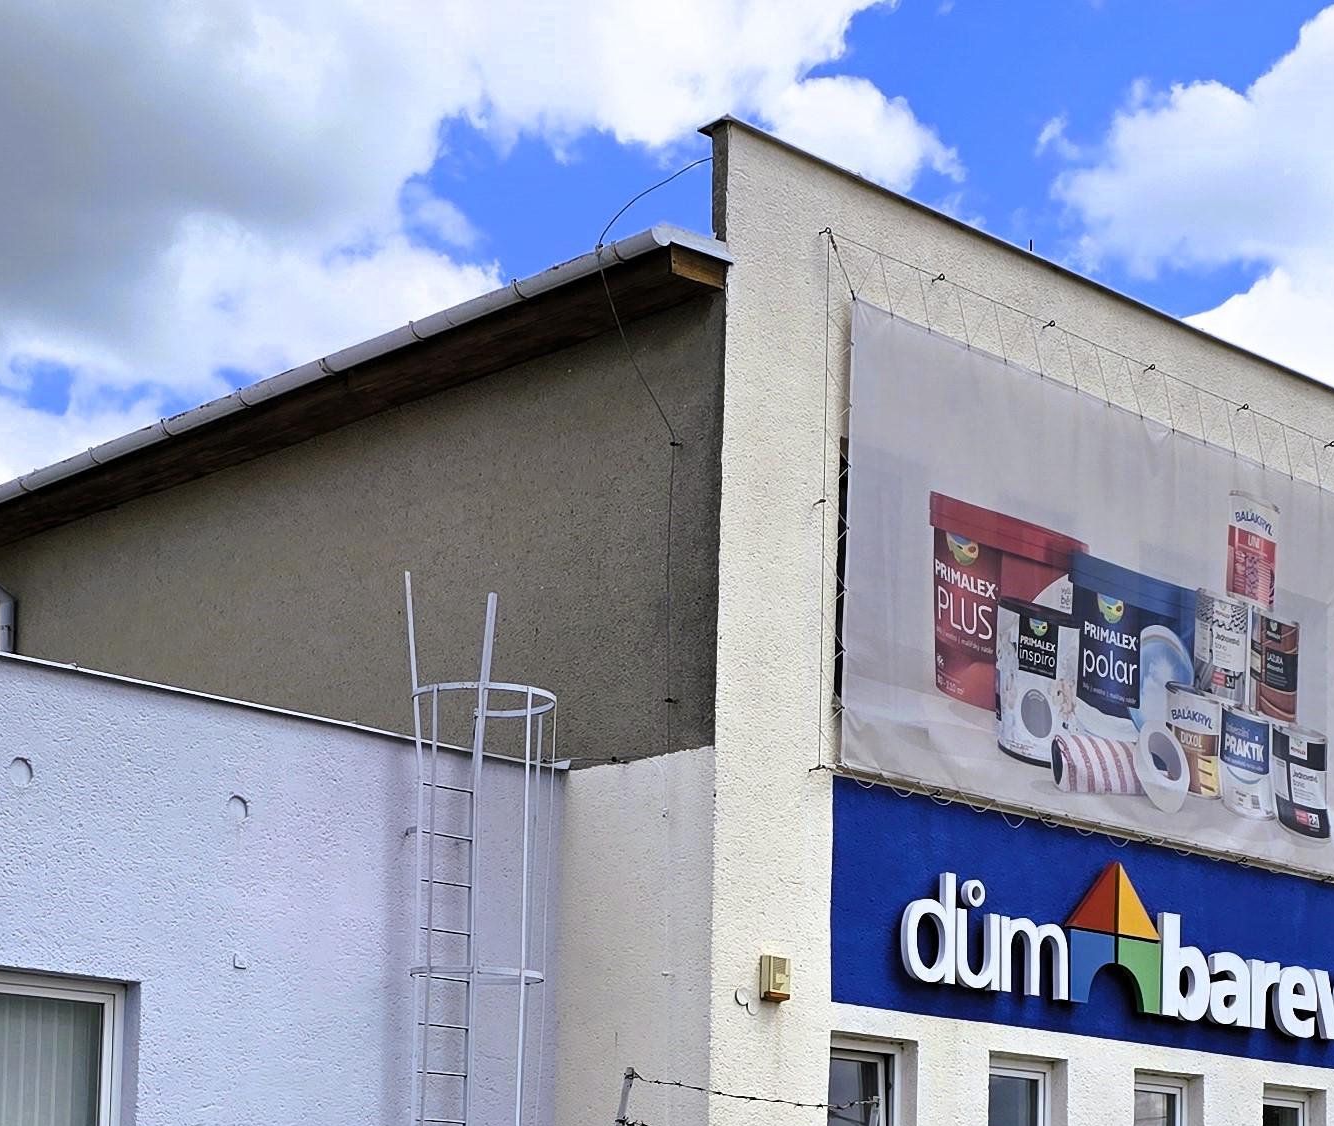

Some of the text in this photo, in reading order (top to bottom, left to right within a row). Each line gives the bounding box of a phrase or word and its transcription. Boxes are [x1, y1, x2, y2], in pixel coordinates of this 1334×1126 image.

[1235, 511, 1273, 536] BALAKRYL
[934, 558, 996, 600] PRIMALEX
[938, 585, 993, 640] PLUS
[1020, 635, 1056, 653] PRIMALEX
[1084, 621, 1137, 651] PRIMALEX
[1019, 645, 1055, 668] inspiro
[1082, 648, 1138, 686] polar
[1171, 709, 1213, 730] BALAKRYL
[1180, 731, 1203, 748] DIXOL
[901, 872, 1069, 1001] dům
